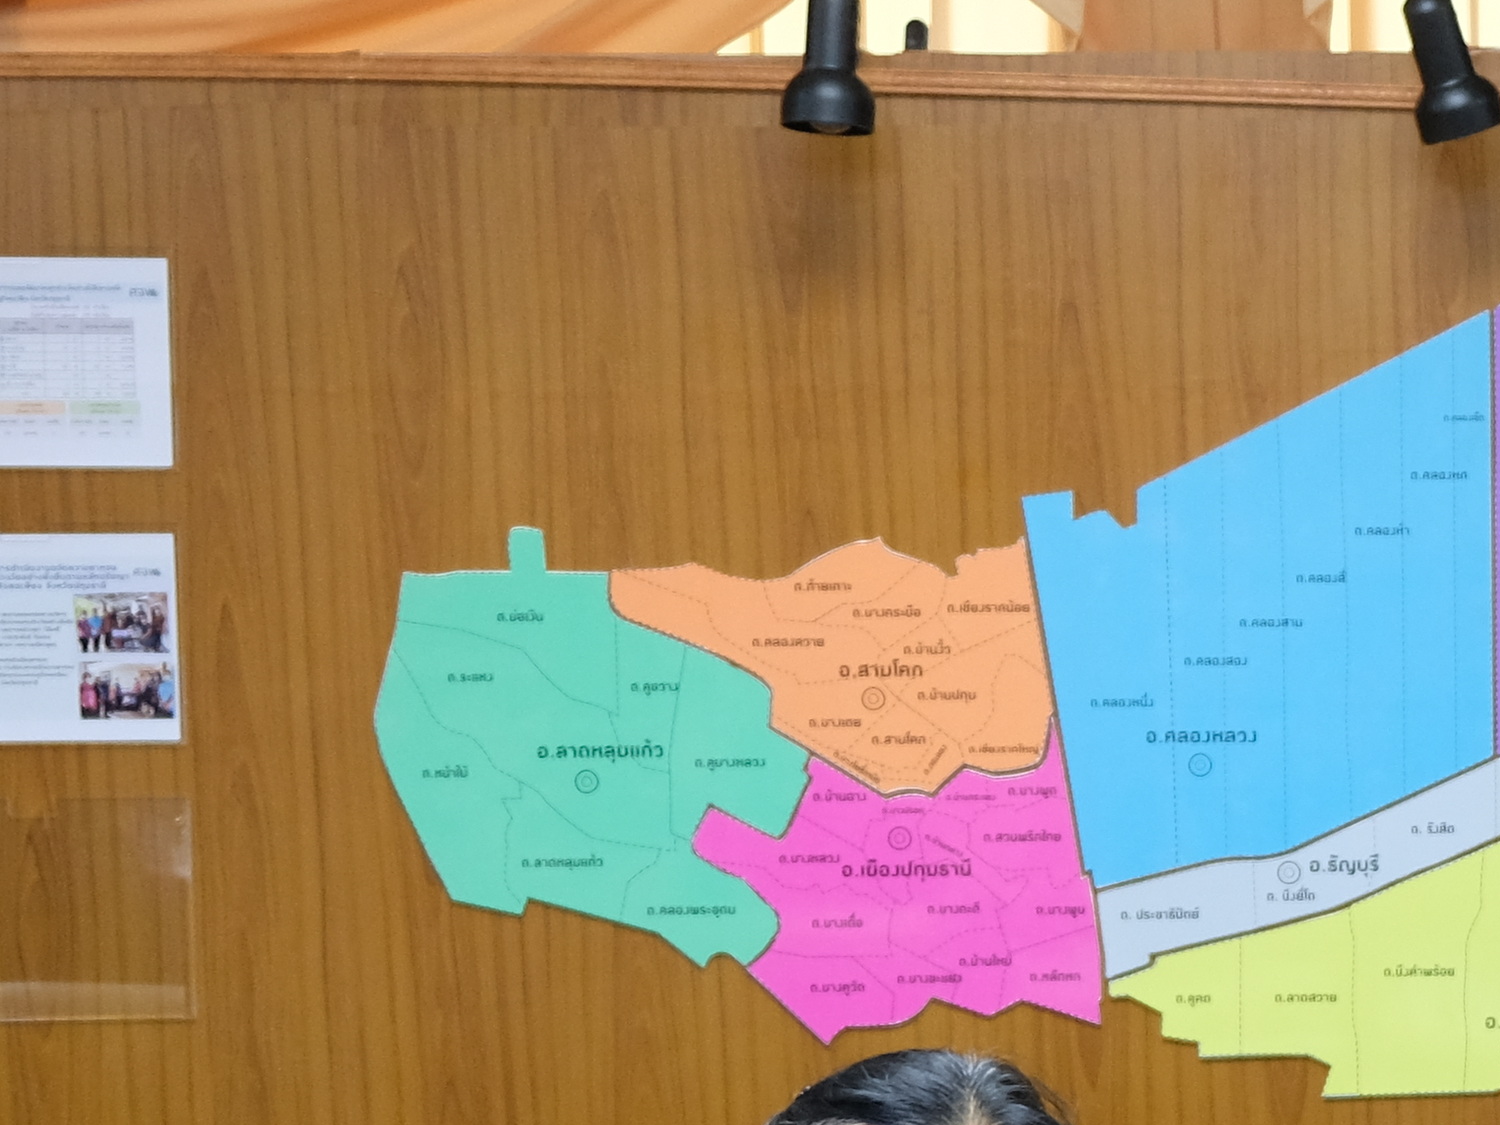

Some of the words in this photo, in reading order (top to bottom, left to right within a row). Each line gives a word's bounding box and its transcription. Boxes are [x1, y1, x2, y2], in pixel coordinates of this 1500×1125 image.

[1354, 522, 1411, 536] ต.คลองห้า
[852, 604, 922, 618] ต.บางกระบือ
[1239, 617, 1303, 628] ต.คลองสาม
[752, 637, 825, 648] ต.คลองควาย
[839, 658, 924, 679] อ.สามโคก
[917, 688, 977, 705] ต.บ้านปทุม
[1090, 692, 1154, 708] ต.คลองหนึ่ง
[870, 731, 927, 745] ต.สามโคก
[1146, 728, 1258, 745] อ.คลองหลวง
[536, 739, 664, 764] อ.ลาดหลุมแก้ว
[695, 755, 766, 772] ต.คูบางหลวง
[983, 828, 1062, 843] ต.สวนพริกไทย
[1427, 823, 1455, 835] รังสิต
[520, 854, 604, 871] ต.ลาดหลุมแก้ว
[842, 857, 972, 883] อ.เมืองปทุมธานี
[1309, 853, 1380, 878] อ.ธัญบุรี
[646, 903, 737, 919] ต.คลองพระอุดม
[1136, 906, 1200, 921] ประชาธิปัตย์
